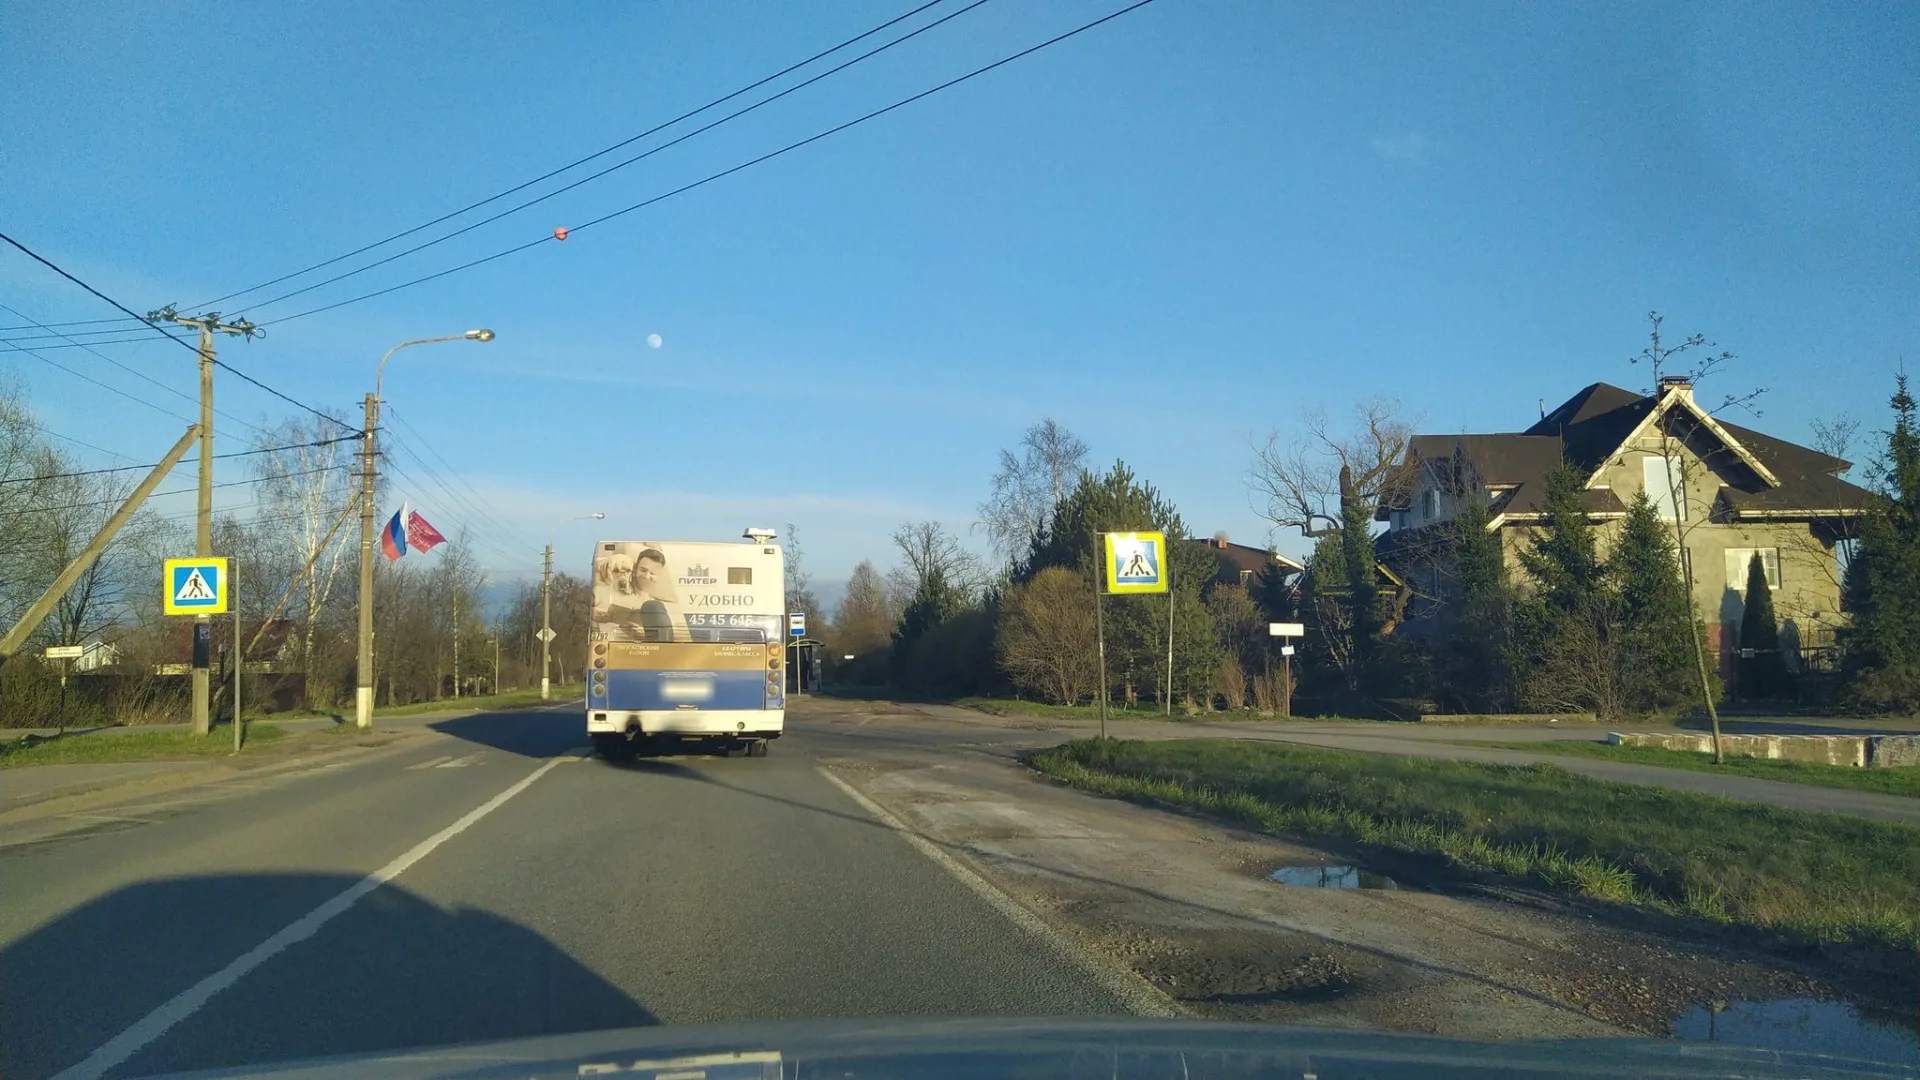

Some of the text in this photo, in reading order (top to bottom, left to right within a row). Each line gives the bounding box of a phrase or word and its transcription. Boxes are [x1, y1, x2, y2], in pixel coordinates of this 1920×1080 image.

[678, 577, 717, 585] ПИТЕР
[689, 595, 754, 607] УДОБНО
[689, 614, 753, 626] 45 45 645
